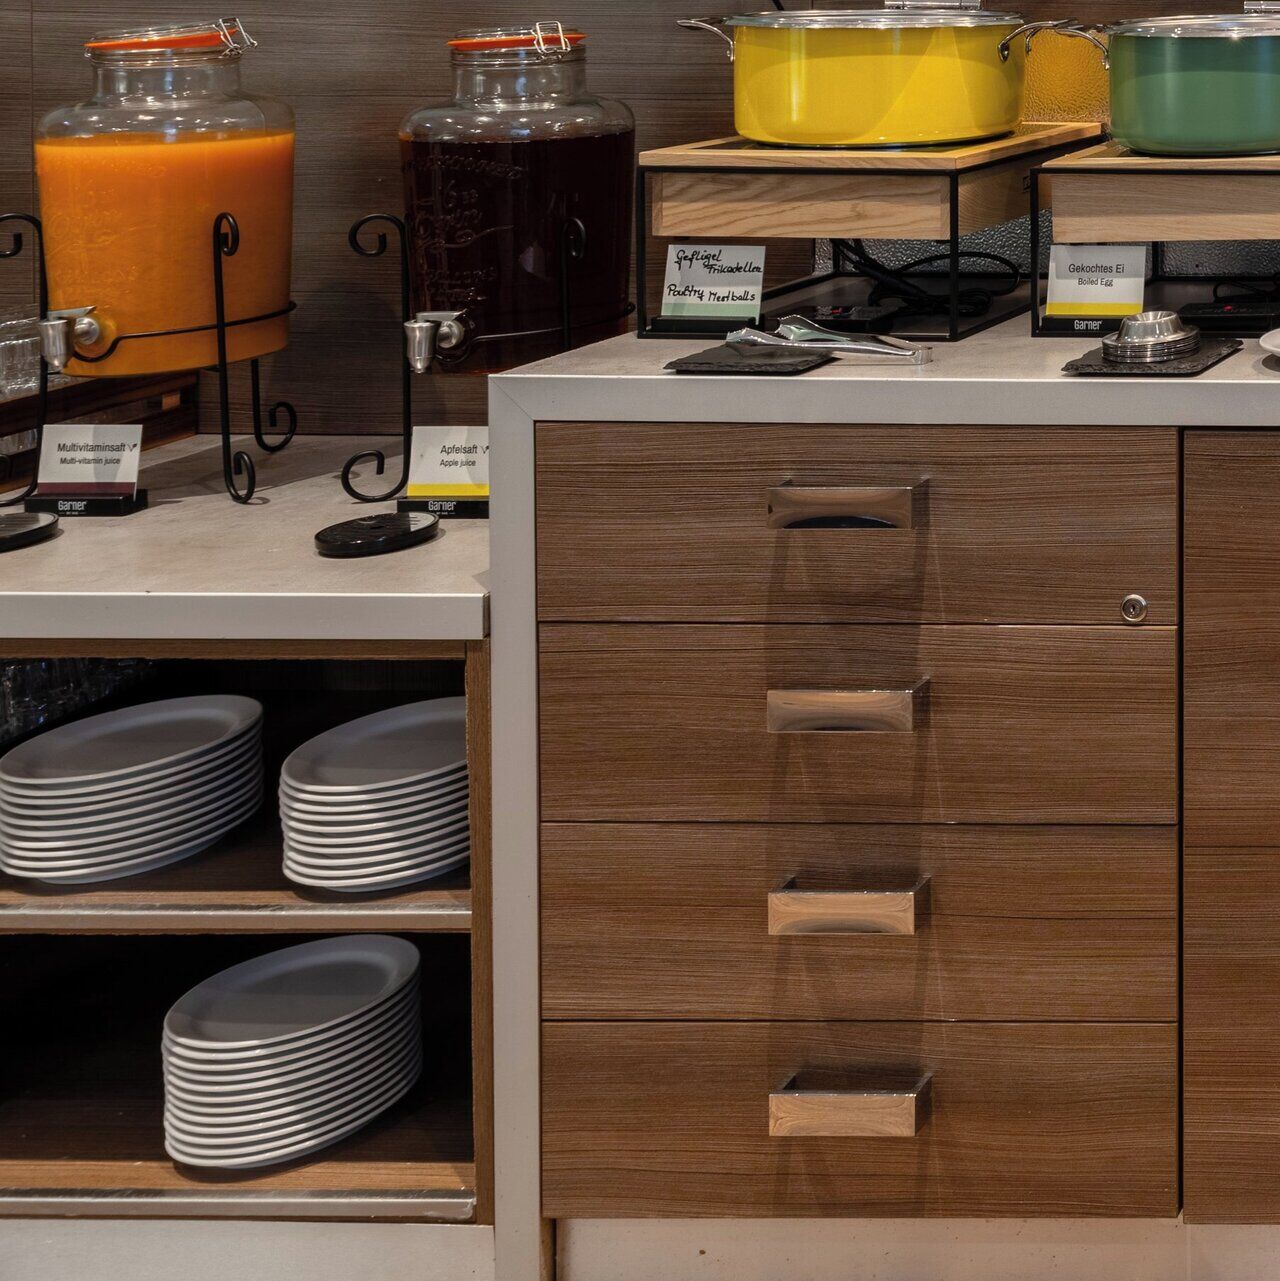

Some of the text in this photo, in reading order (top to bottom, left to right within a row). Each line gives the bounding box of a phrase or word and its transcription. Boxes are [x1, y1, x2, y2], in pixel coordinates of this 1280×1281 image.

[674, 248, 722, 271] Geflügel
[1068, 263, 1125, 274] Gekochtes Ei
[1078, 278, 1114, 288] Boiled Egg
[1074, 320, 1102, 330] Garner
[57, 442, 126, 452] Multivitaminsaft
[440, 444, 478, 455] Apfelsaft
[104, 457, 120, 466] juice
[440, 459, 476, 468] Apple juice
[58, 500, 87, 510] Garner
[428, 500, 456, 511] Garner
